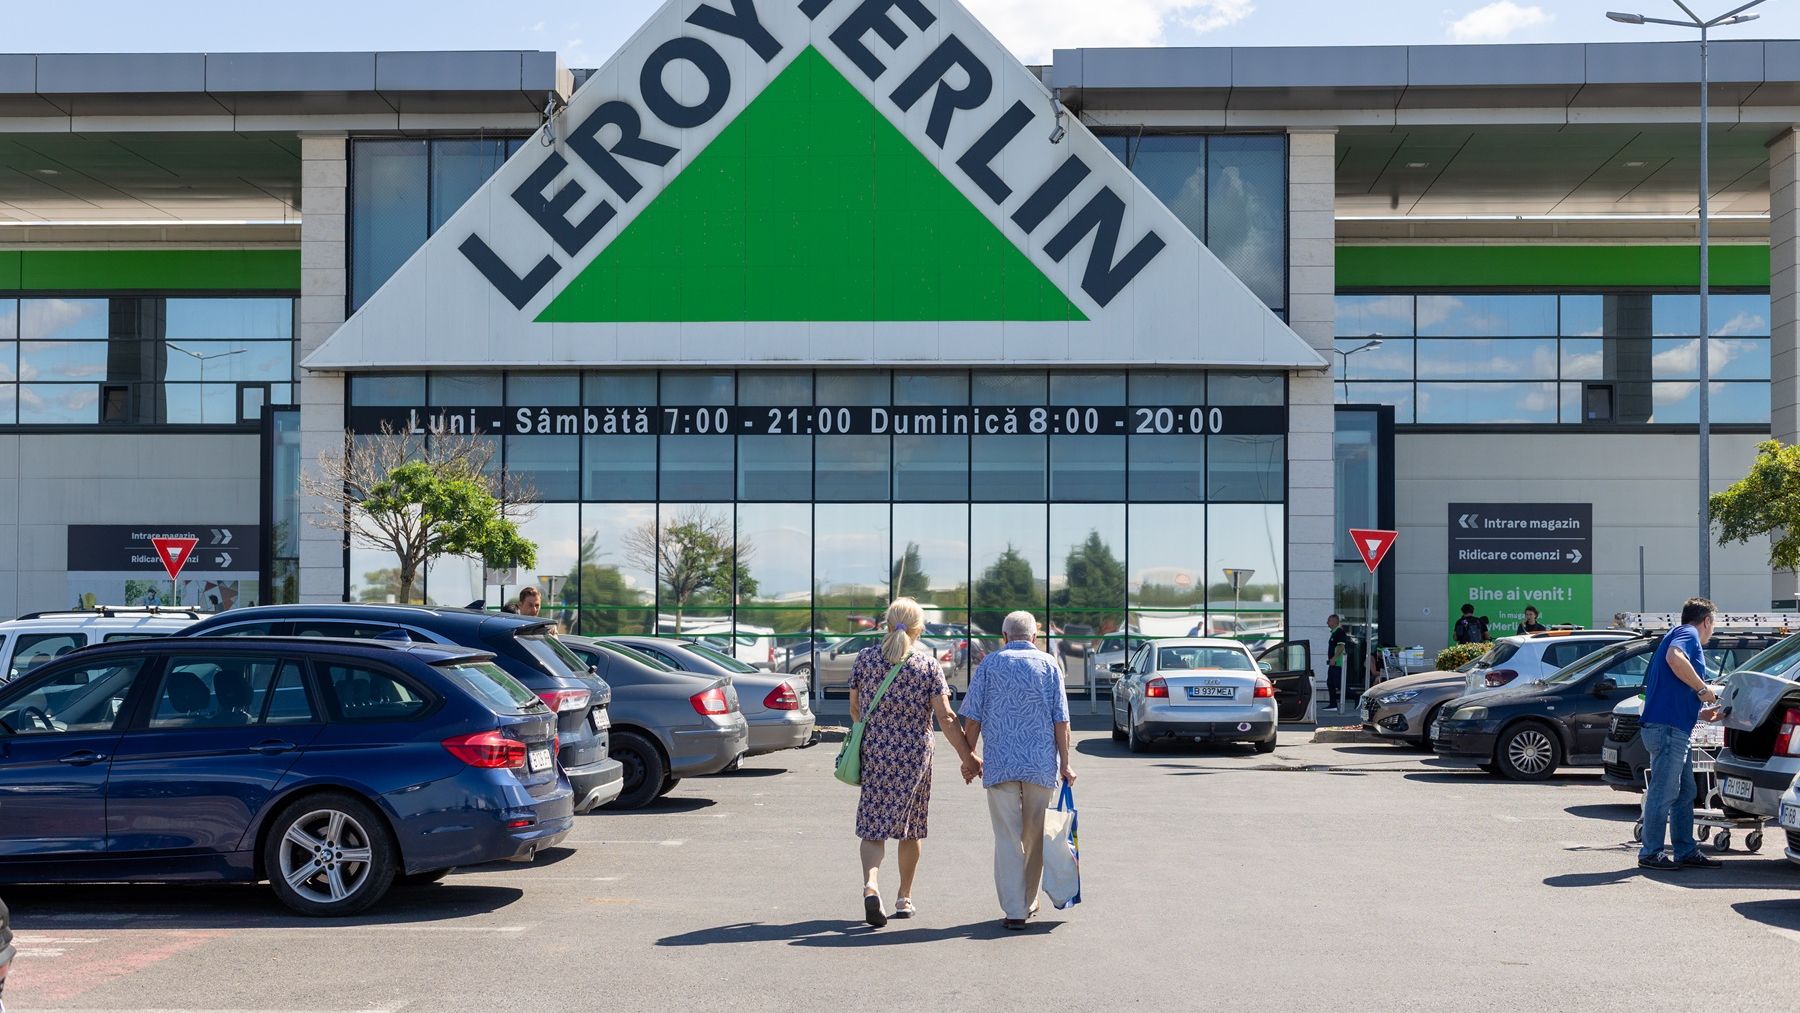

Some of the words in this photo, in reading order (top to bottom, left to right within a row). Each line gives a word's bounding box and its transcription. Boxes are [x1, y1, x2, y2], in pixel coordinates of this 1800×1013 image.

[458, 0, 784, 311] LEROY
[797, 0, 1166, 309] ERLIN
[410, 408, 476, 434] Luni
[515, 407, 649, 434] Sâmbătă
[664, 408, 729, 434] 7:00
[767, 407, 851, 434] 21:00
[871, 407, 1018, 434] Duminică
[1028, 407, 1099, 434] 8:00
[1135, 407, 1223, 434] 20:00
[1484, 518, 1527, 529] Intrare
[1529, 518, 1580, 531] magazin
[1458, 549, 1508, 560] Ridicare
[1509, 549, 1560, 560] comenzi
[1468, 586, 1504, 601] Bine
[1506, 586, 1520, 600] ai
[1523, 586, 1565, 601] venit
[1567, 587, 1572, 600] !
[1194, 687, 1200, 695] B
[1202, 687, 1216, 695] 937
[1216, 688, 1232, 696] MEA
